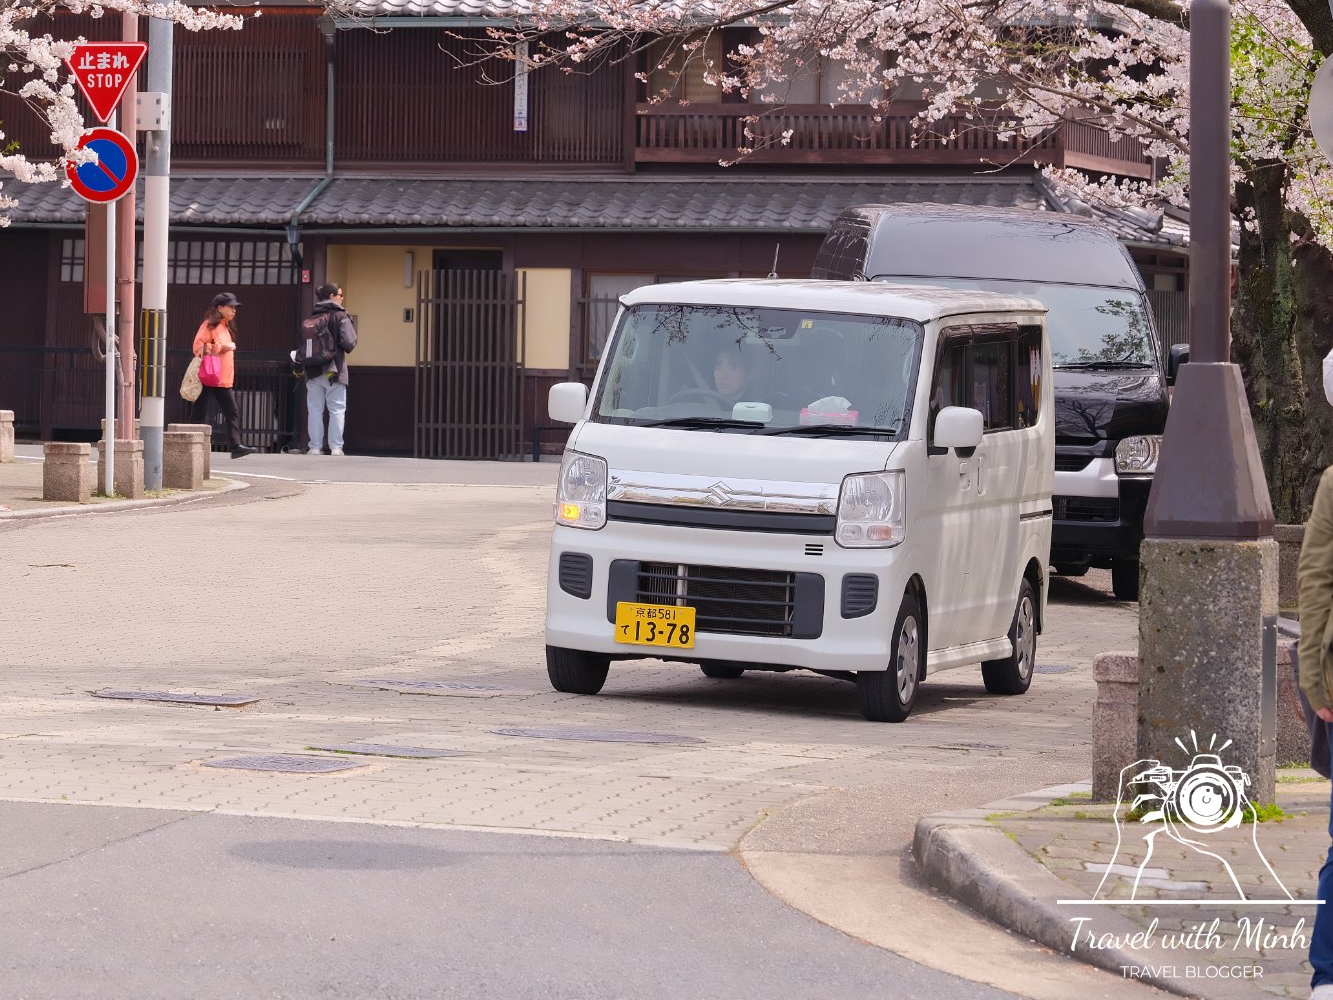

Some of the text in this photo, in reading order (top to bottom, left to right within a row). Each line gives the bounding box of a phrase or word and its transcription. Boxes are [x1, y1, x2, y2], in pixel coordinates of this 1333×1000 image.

[78, 52, 130, 70] 止まれ
[87, 74, 122, 89] STOP
[636, 607, 677, 620] 京都581
[620, 621, 690, 645] て 13-78
